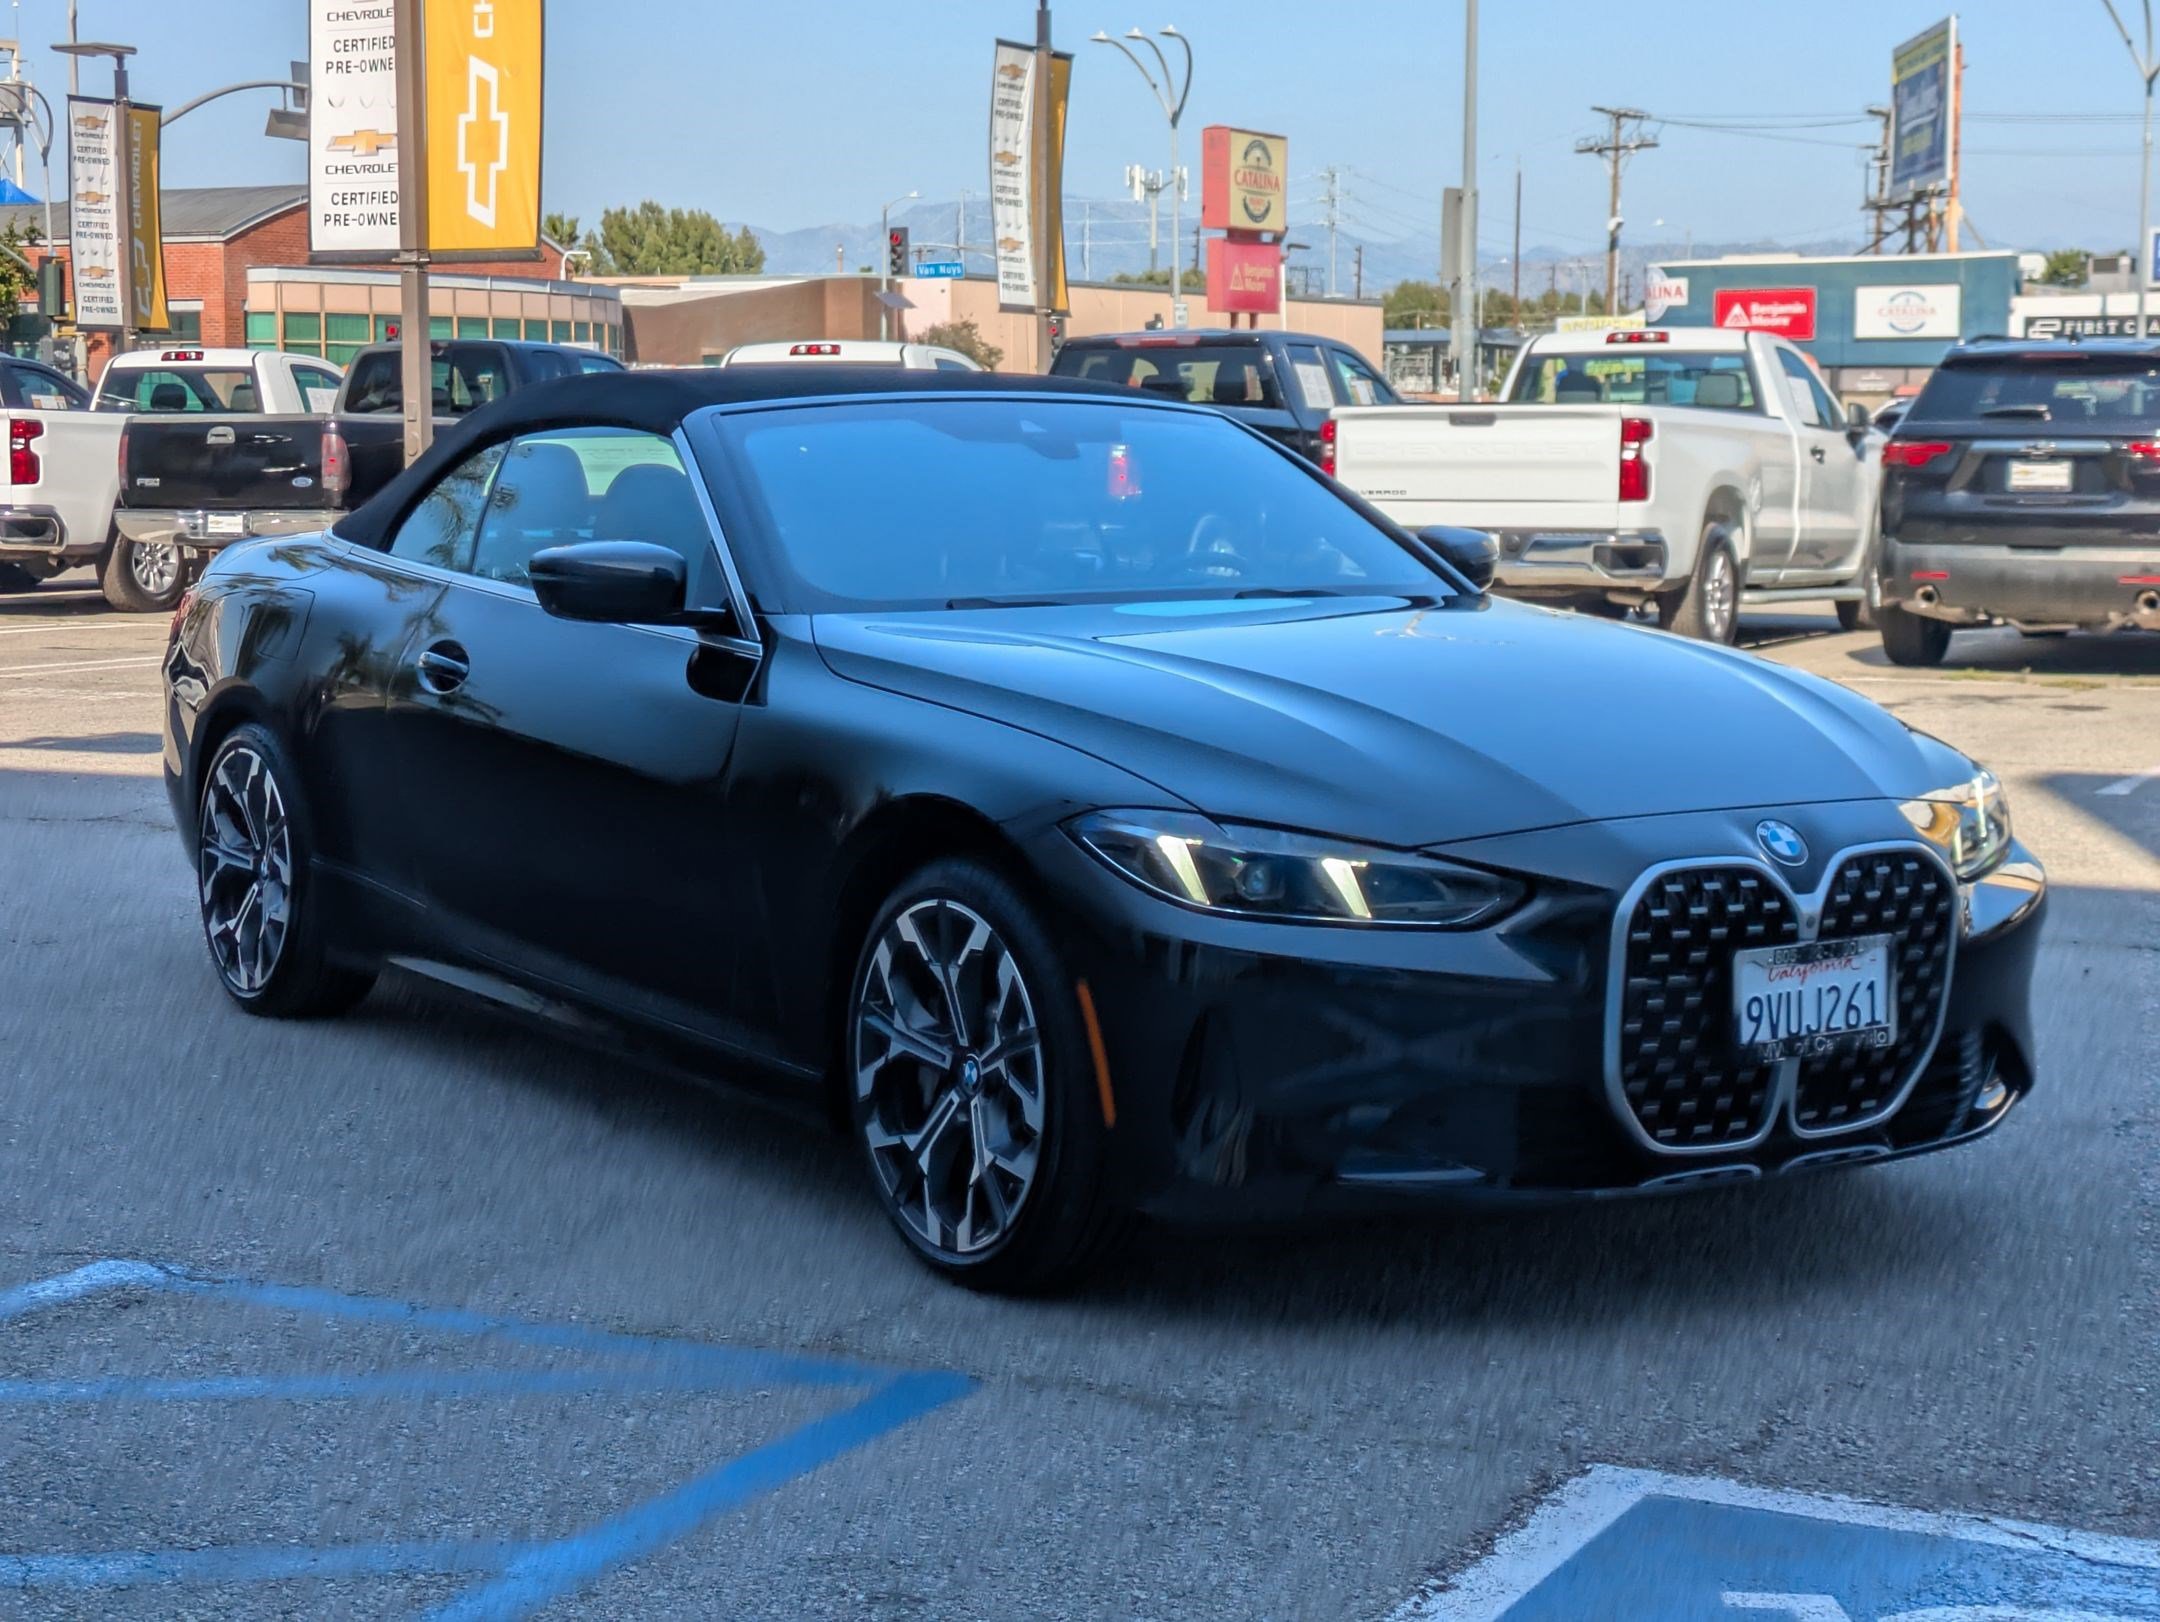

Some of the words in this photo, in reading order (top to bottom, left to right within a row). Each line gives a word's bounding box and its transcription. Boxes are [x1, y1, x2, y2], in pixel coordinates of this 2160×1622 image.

[326, 7, 394, 22] CHEVROLE
[333, 35, 395, 53] CERTIFIED
[325, 57, 394, 74] PRE-OWNE
[77, 145, 108, 155] CERTIFIED
[73, 156, 110, 165] PRE-OWNED
[132, 121, 142, 229] CHEVROLET
[325, 162, 398, 175] CHEVROLE
[1234, 169, 1280, 192] CATALINA
[331, 190, 398, 206] CERTIFIED
[78, 221, 109, 230] CERTIFIED
[324, 212, 398, 227] PRE-OWNE
[76, 231, 113, 240] PRE-OWNED
[919, 266, 935, 275] Van
[940, 265, 961, 275] Nuys
[83, 296, 114, 304] CERTIFIED
[82, 306, 118, 314] PRE-OWNED
[1751, 301, 1807, 318] Benjamin
[1879, 307, 1936, 317] CATALINA
[1751, 315, 1790, 327] Moore
[2064, 320, 2118, 335] FIRST
[1746, 980, 1882, 1044] 9VUJ261
